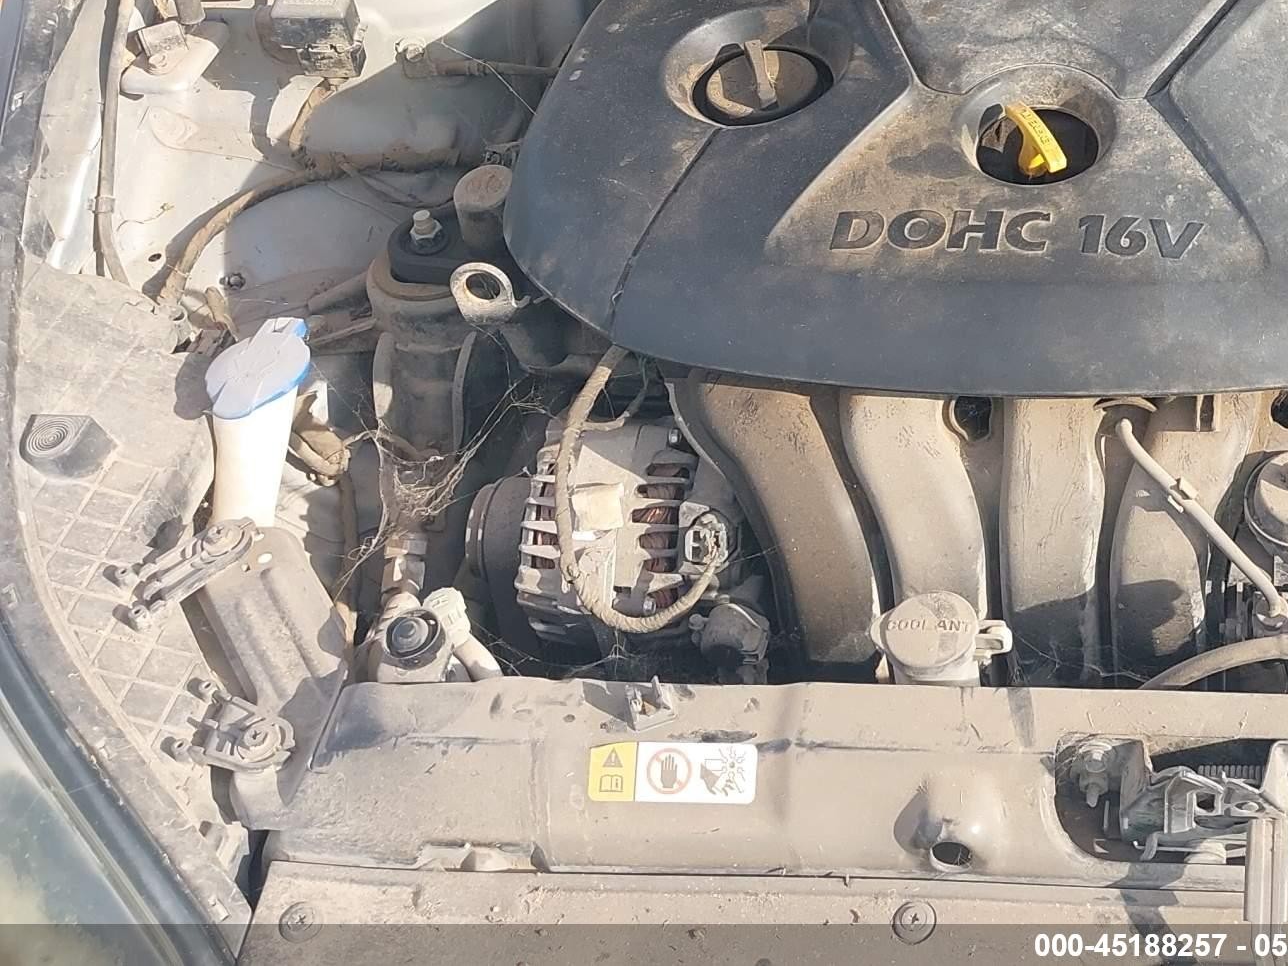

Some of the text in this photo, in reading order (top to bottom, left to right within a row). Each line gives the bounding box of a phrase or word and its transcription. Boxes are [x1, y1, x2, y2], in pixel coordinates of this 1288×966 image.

[830, 209, 1205, 260] DOHC 16V
[886, 617, 971, 633] COOLANT
